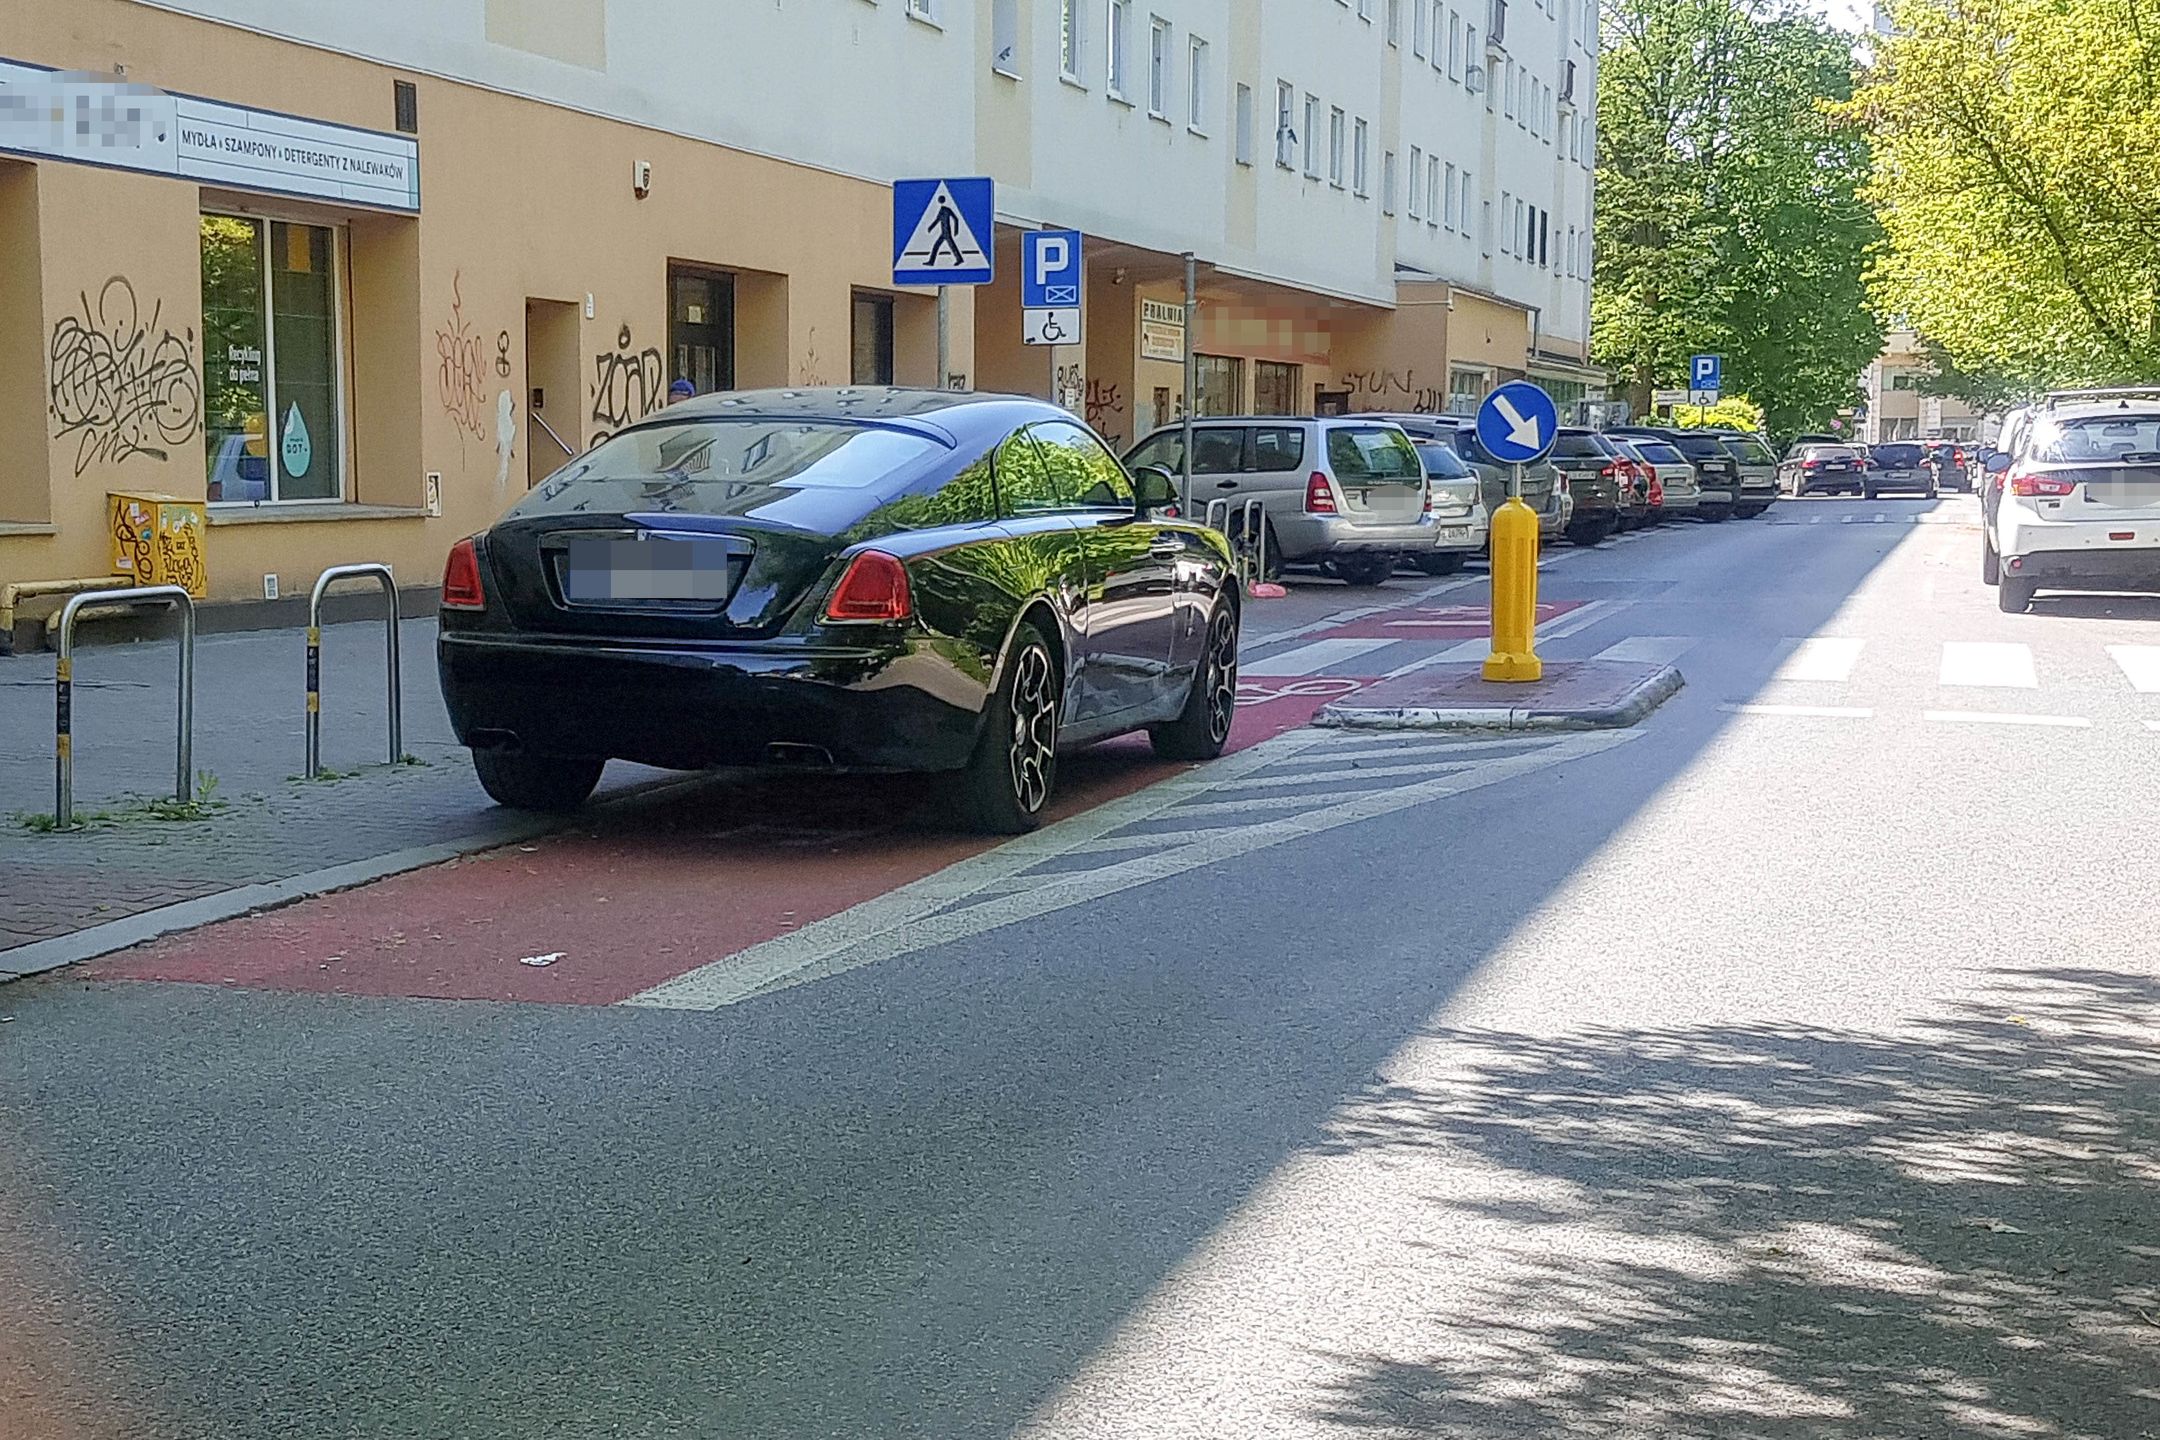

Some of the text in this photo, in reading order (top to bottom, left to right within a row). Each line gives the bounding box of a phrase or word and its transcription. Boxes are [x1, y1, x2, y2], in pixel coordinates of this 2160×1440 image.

[182, 129, 404, 180] MYDŁA SZAMPONY DETERGENTY Z NALEWAKÓW
[1036, 237, 1069, 285] P
[1143, 302, 1183, 323] PRALNIA
[1696, 358, 1714, 381] P
